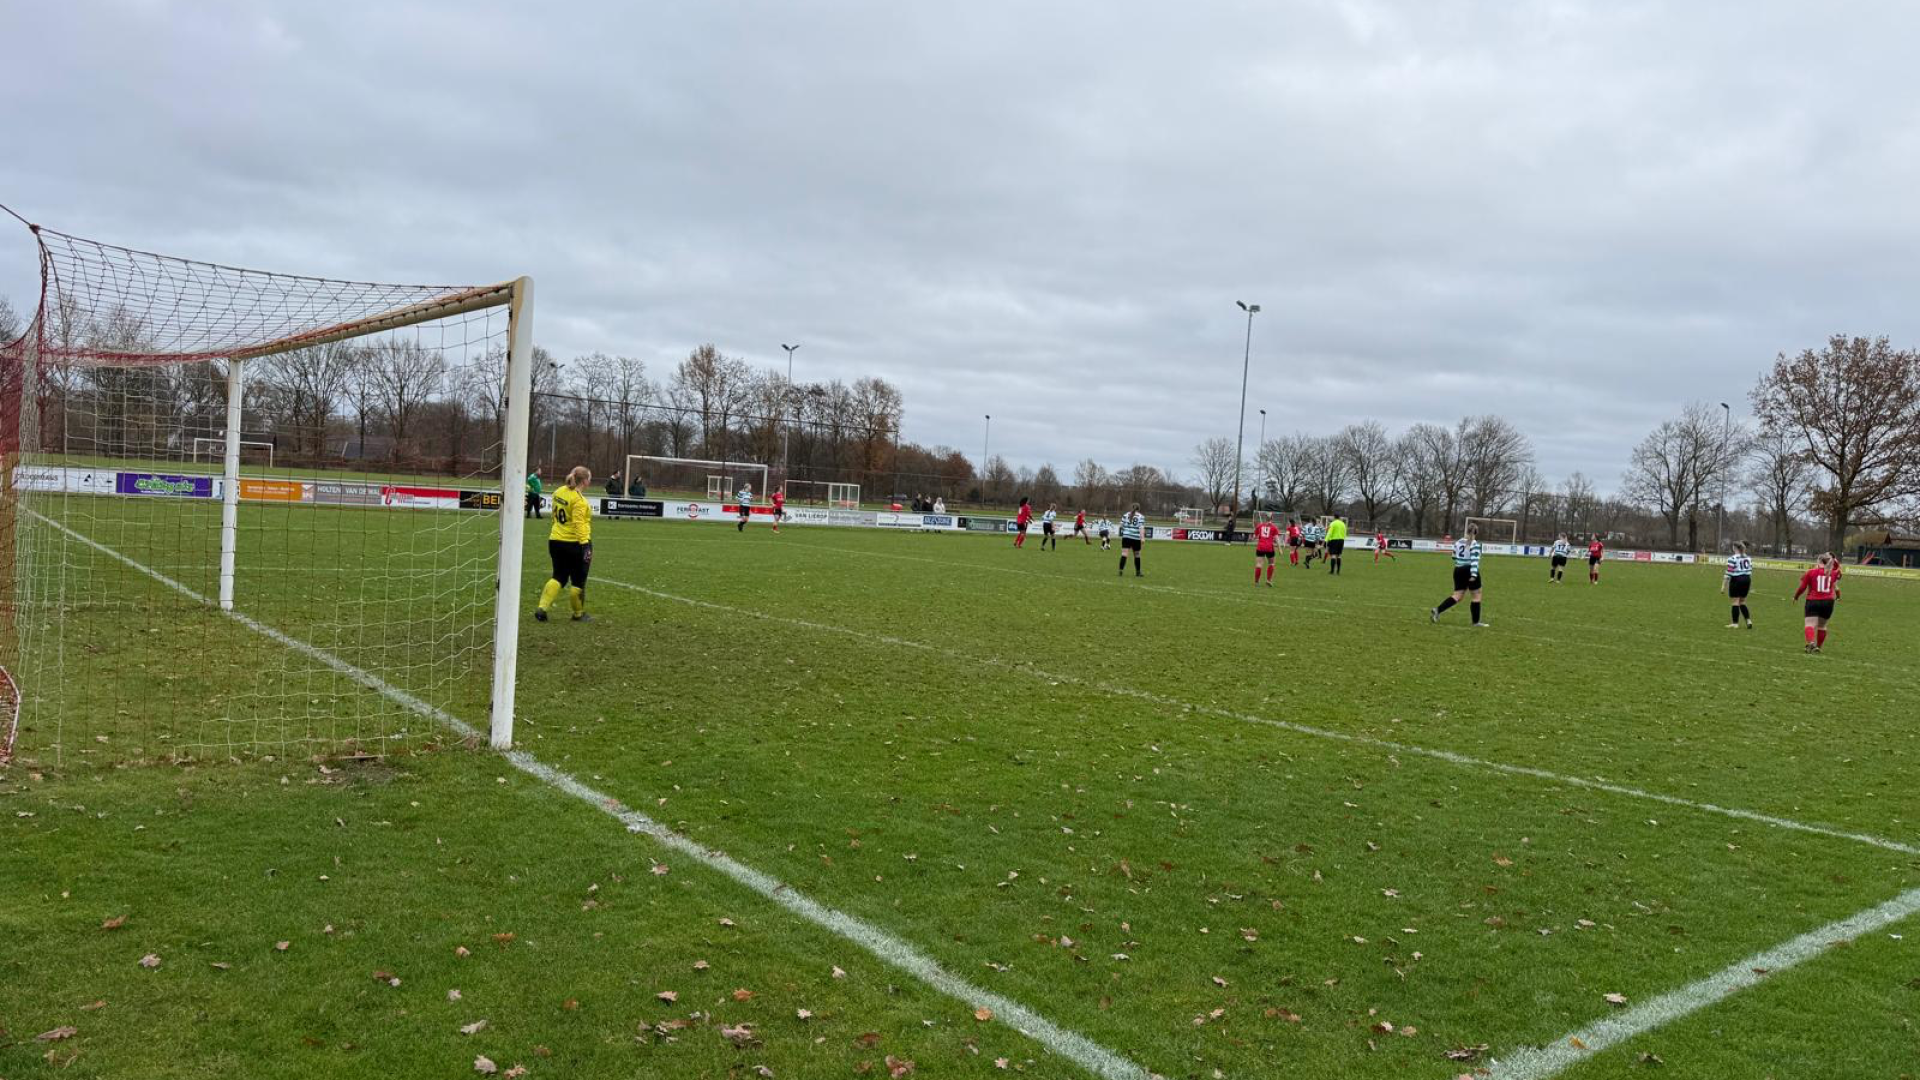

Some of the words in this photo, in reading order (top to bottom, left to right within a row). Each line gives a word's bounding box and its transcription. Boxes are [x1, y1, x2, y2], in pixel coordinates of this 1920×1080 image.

[1458, 545, 1466, 558] 2
[1739, 559, 1751, 570] 10
[1816, 575, 1832, 593] 10
